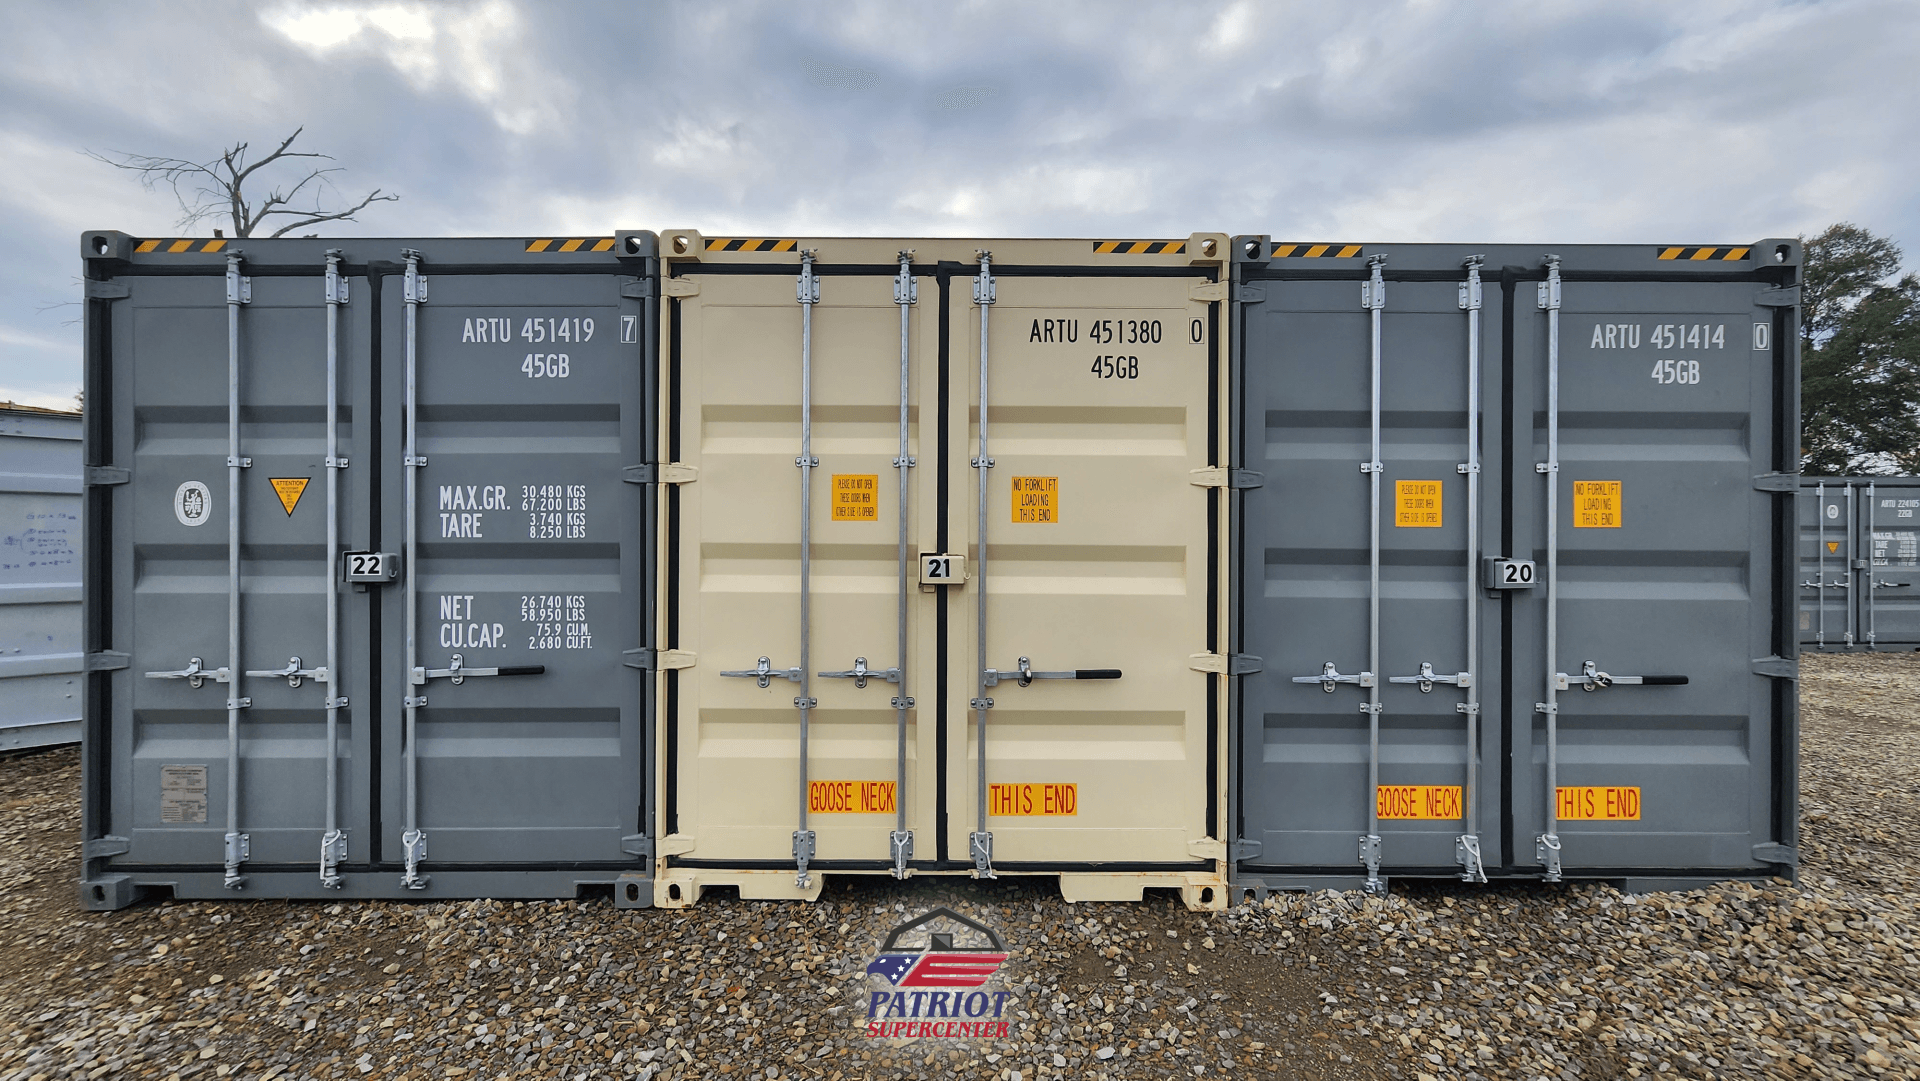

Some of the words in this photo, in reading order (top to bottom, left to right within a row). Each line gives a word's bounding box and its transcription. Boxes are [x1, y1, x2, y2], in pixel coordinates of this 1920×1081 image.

[462, 318, 511, 343] ARTU
[521, 318, 595, 343] 451419
[623, 317, 635, 342] 7
[1030, 319, 1078, 343] ARTU
[1090, 320, 1162, 344] 451380
[1590, 324, 1640, 349] ARTU
[1650, 324, 1725, 349] 451414
[521, 354, 570, 378] 45GB
[1091, 355, 1139, 379] 45GB
[1651, 360, 1700, 384] 45GB
[567, 485, 586, 498] KGS
[838, 479, 850, 489] PLEASE
[864, 479, 872, 489] OPEN
[1013, 478, 1022, 491] NO
[1025, 478, 1057, 491] FORKLIFT
[1576, 483, 1584, 495] NO
[1588, 483, 1619, 495] FORKLIFT
[439, 485, 511, 510] MAX.GR.
[567, 498, 586, 511] LBS
[840, 493, 850, 502] THESE
[851, 493, 861, 502] DOORS
[862, 493, 870, 502] WHEN
[1021, 493, 1049, 506] LOADING
[1584, 498, 1611, 510] LOADING
[567, 513, 586, 526] KGS
[1019, 508, 1035, 521] THIS
[1038, 508, 1051, 521] END
[1582, 513, 1597, 525] THIS
[1601, 513, 1613, 525] END
[440, 513, 483, 538] TARE
[567, 526, 586, 539] LBS
[353, 556, 380, 574] 22
[929, 558, 950, 578] 21
[1505, 564, 1532, 582] 20
[440, 595, 474, 620] NET
[566, 595, 585, 608] KGS
[566, 608, 586, 621] LBS
[440, 623, 507, 648] CU.CAP.
[536, 623, 562, 636] 75.9
[566, 623, 591, 636] CU.M.
[566, 636, 593, 649] CU.FT.
[810, 782, 852, 812] GOOSE
[861, 782, 895, 812] NECK
[990, 785, 1032, 814] THIS
[1044, 785, 1076, 814] END
[1377, 788, 1417, 817] GOOSE
[1426, 788, 1460, 817] NECK
[1556, 789, 1594, 818] THIS
[1606, 789, 1637, 818] END
